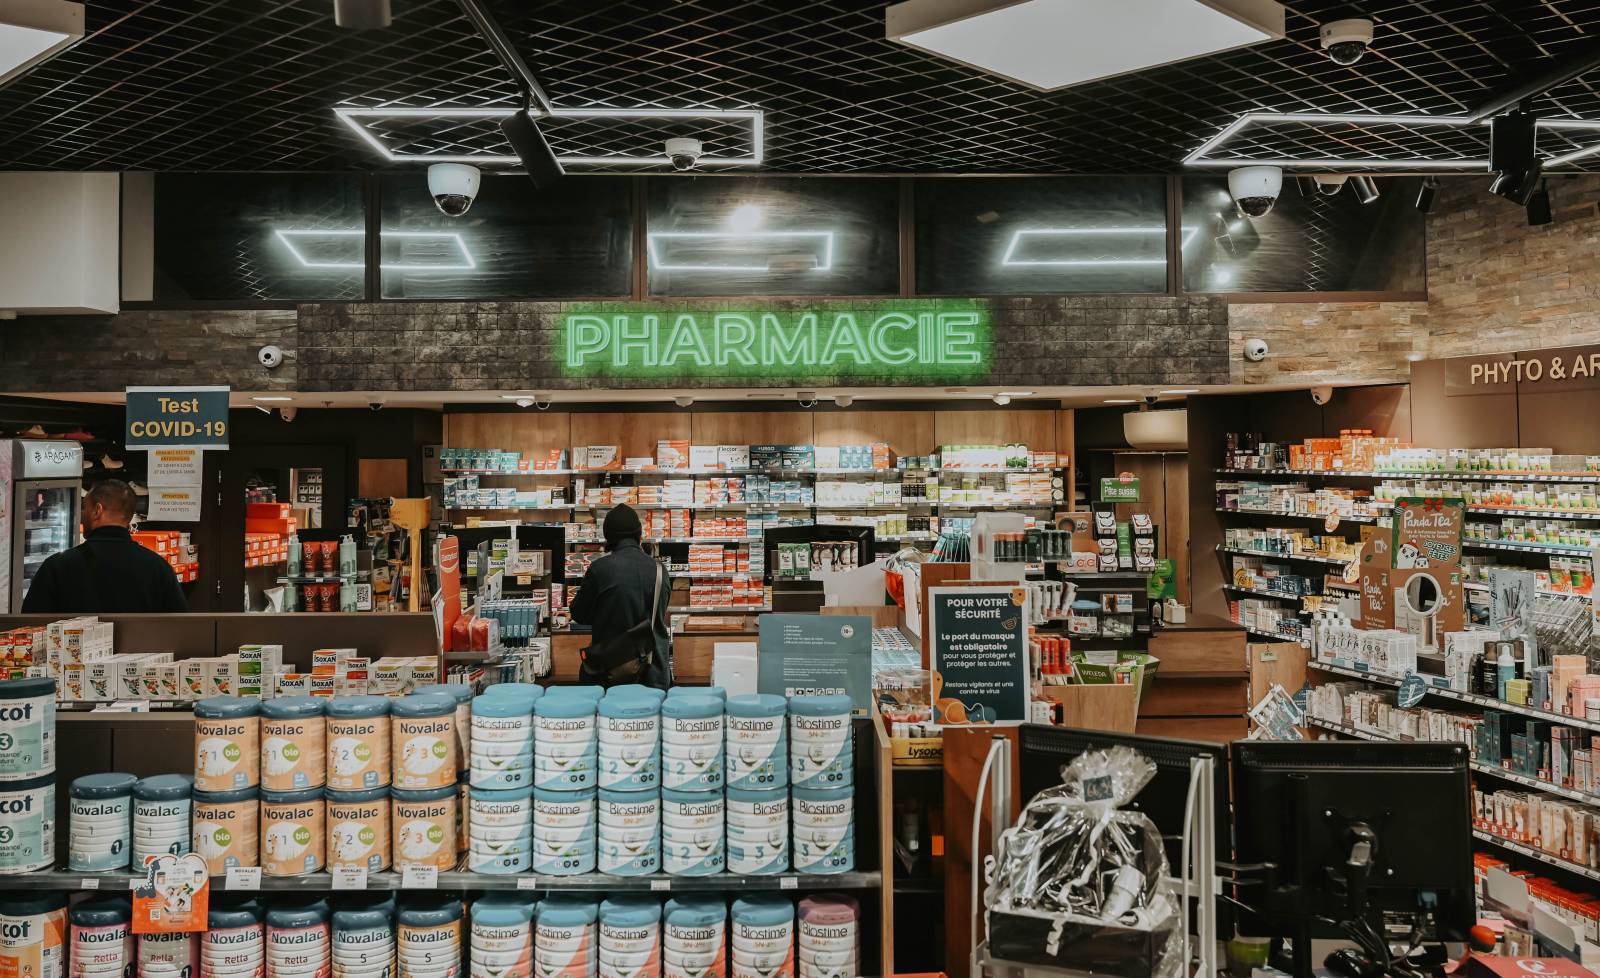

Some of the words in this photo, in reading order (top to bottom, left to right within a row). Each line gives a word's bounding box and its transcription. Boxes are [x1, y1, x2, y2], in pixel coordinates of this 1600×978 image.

[566, 313, 980, 366] PHARMACIE
[1471, 358, 1543, 385] PHYTO
[1550, 356, 1566, 380] &
[158, 397, 199, 413] Test
[130, 421, 226, 438] COVID-19
[44, 451, 74, 462] ARAGAN
[1403, 510, 1432, 529] Panda
[1433, 512, 1453, 527] Tea
[1424, 540, 1457, 555] JOYEUSES
[947, 598, 973, 607] POUR
[976, 598, 1008, 607] VOTRE
[955, 608, 1001, 619] SÉCURITÉ
[951, 633, 969, 644] port
[982, 633, 1015, 644] masque
[963, 643, 1008, 652] obligatoire
[943, 653, 959, 661] pour
[978, 652, 1007, 661] protéger
[946, 660, 976, 668] protéger
[375, 670, 398, 678] ISOXAN
[412, 669, 435, 678] ISOXAN
[280, 677, 305, 687] ISOXAN
[197, 723, 245, 735] Novalac
[400, 722, 450, 734] Novalac
[476, 717, 522, 729] Biostime
[540, 717, 585, 730] Biostime
[609, 717, 654, 731] Biostime
[675, 719, 720, 732] Biostime
[730, 716, 774, 730] Biostime
[796, 716, 842, 729] Biostime
[0, 735, 9, 749] 3
[225, 748, 240, 756] bio
[284, 748, 298, 756] bio
[434, 745, 447, 754] bio
[71, 804, 122, 816] Novalac
[264, 807, 314, 820] Novalac
[329, 807, 379, 820] Novalac
[397, 806, 446, 818] Novalac
[474, 800, 520, 814] Biostime
[609, 802, 655, 815] Biostime
[799, 800, 846, 814] Biostime
[0, 827, 9, 840] 3
[215, 832, 230, 841] bio
[295, 831, 309, 840] bio
[360, 831, 374, 840] bio
[429, 830, 442, 838] bio
[113, 842, 120, 852] 1
[338, 929, 391, 944] Novalac
[403, 929, 454, 943] Novalac
[474, 924, 520, 938] Biostime
[603, 925, 648, 939] Biostime
[671, 926, 716, 940] Biostime
[740, 924, 787, 939] Biostime
[803, 922, 848, 939] Biostime
[210, 930, 263, 945] Novalac
[272, 930, 323, 945] Novalac
